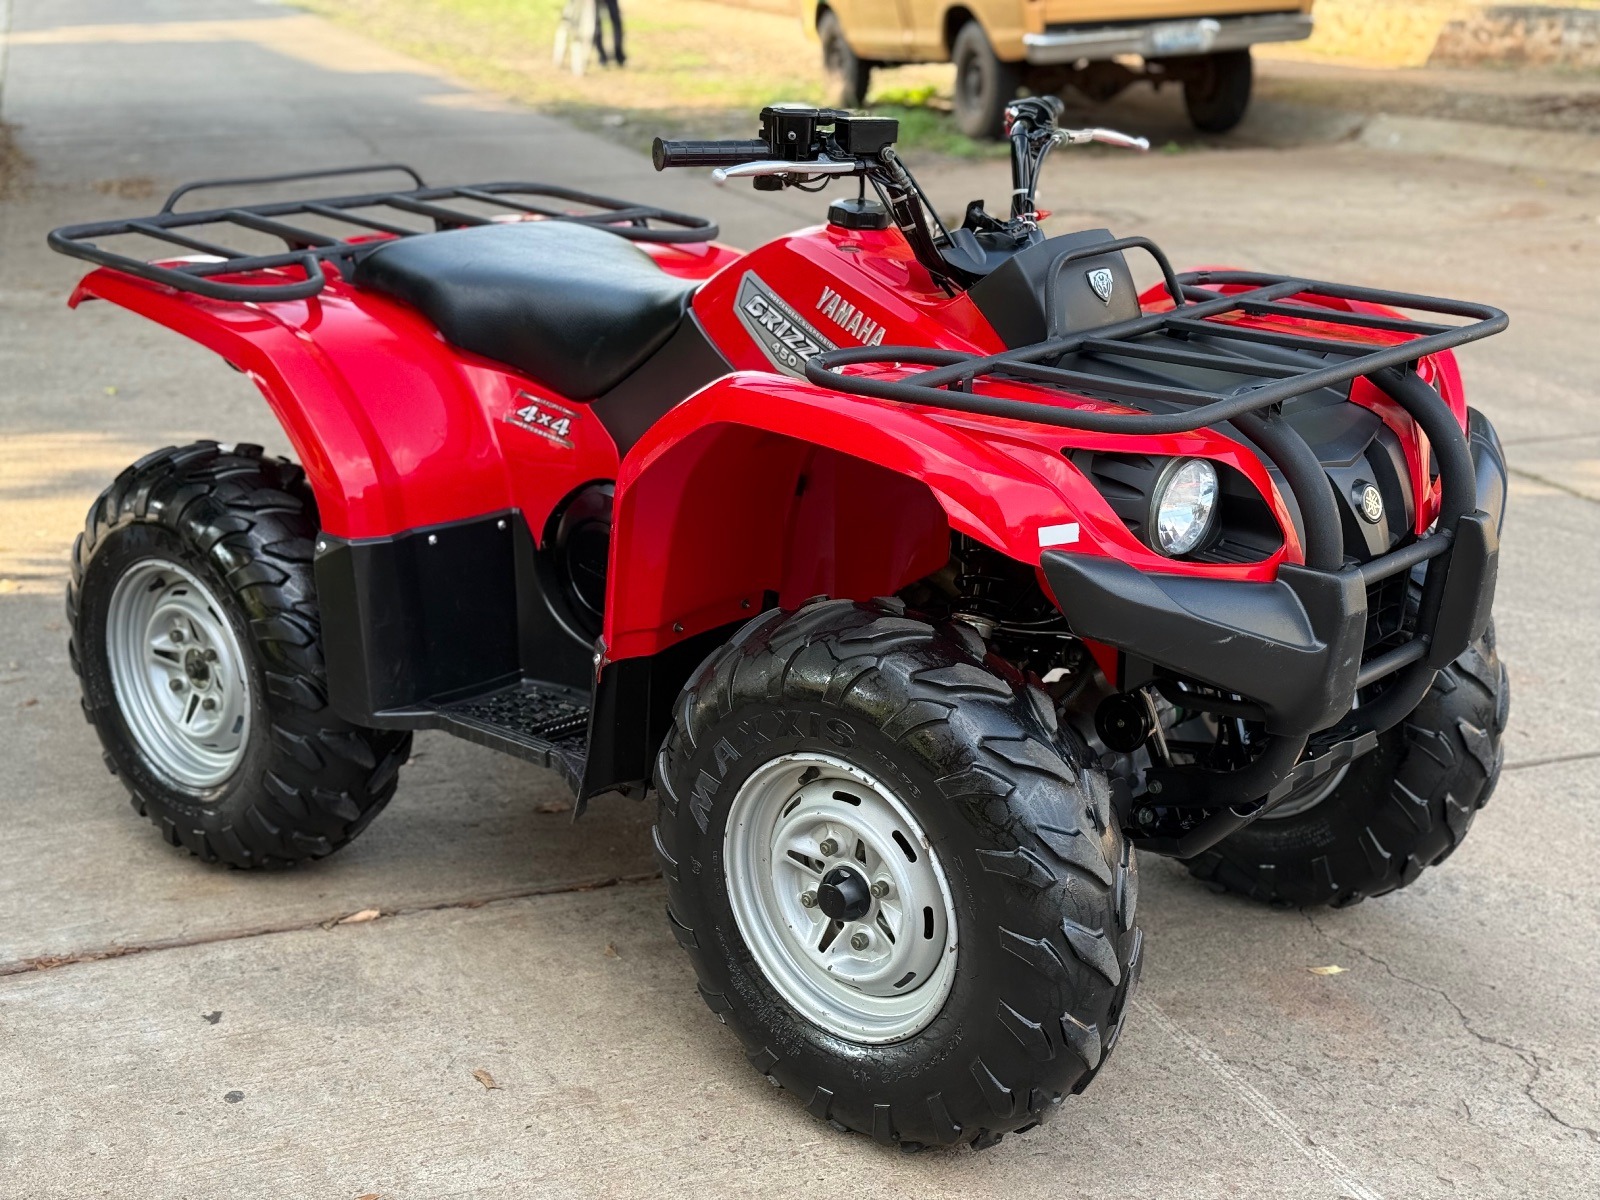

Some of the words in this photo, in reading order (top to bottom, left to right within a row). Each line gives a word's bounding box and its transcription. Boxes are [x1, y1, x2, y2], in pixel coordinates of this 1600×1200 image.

[744, 295, 828, 363] GRIZZ
[815, 285, 887, 347] YAMAHA
[771, 342, 797, 367] 450
[516, 405, 571, 436] 4x4
[689, 710, 856, 834] MAXXIS
